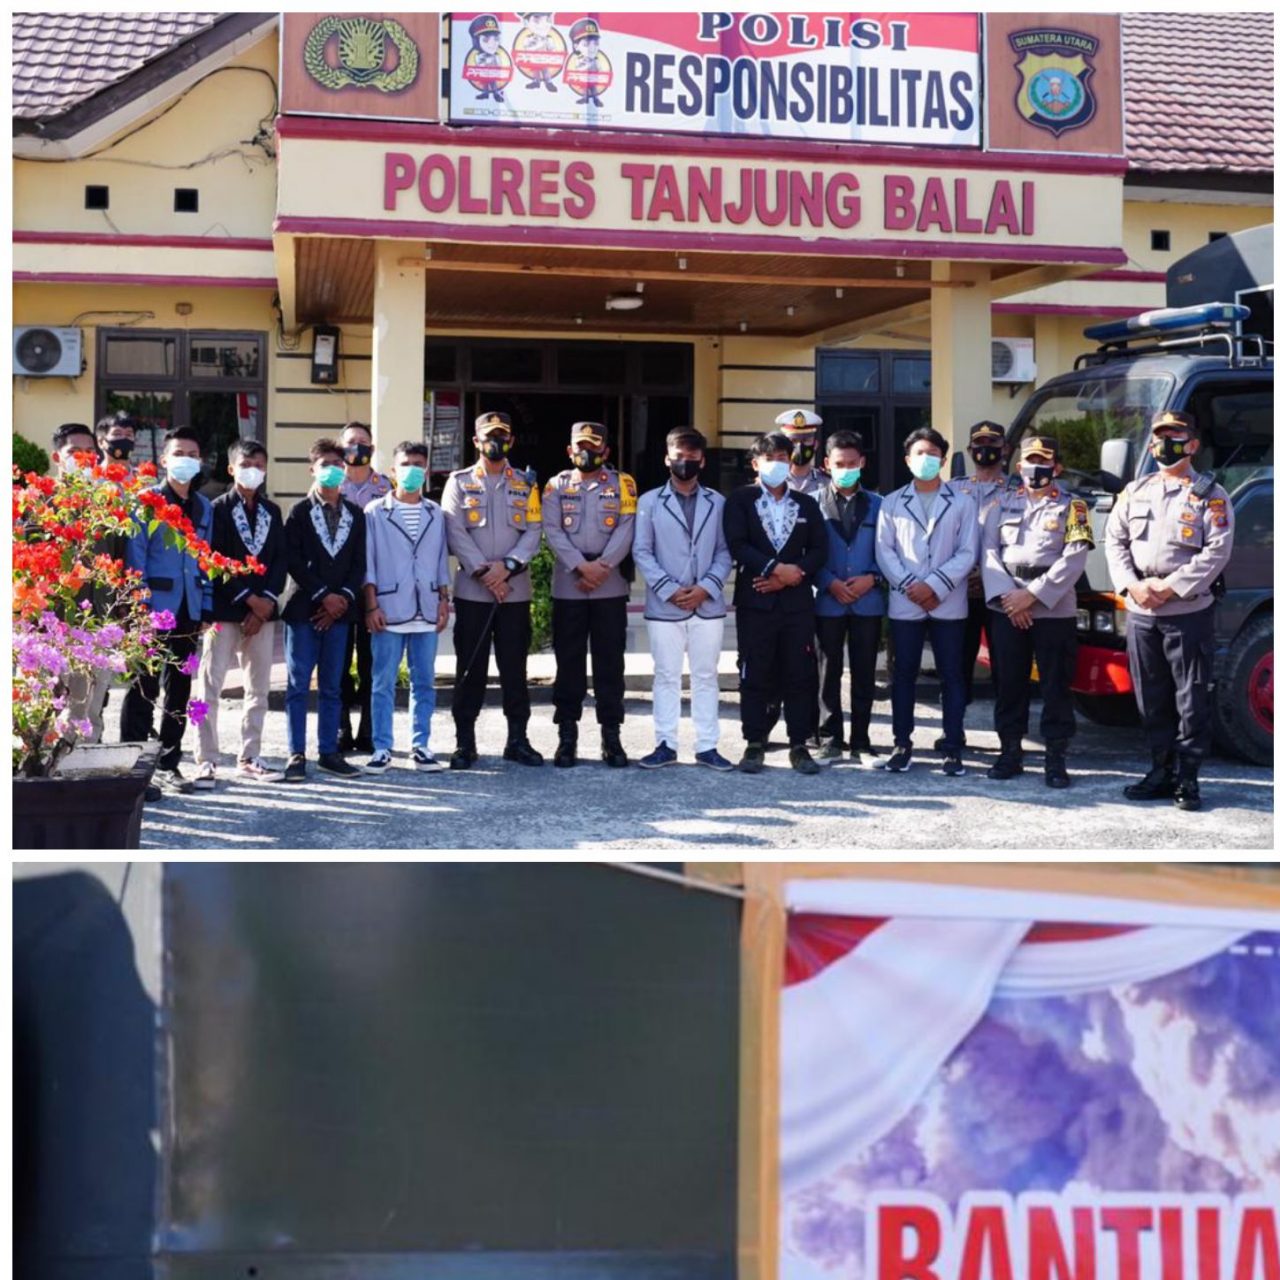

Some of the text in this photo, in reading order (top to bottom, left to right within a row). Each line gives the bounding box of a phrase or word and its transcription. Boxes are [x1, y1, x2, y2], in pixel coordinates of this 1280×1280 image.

[699, 13, 907, 51] POLISI
[1015, 33, 1093, 51] SUMATERA UTARA
[624, 51, 975, 131] RESPONSIBILITAS
[383, 150, 1036, 237] POLRES TANJUNG BALAI
